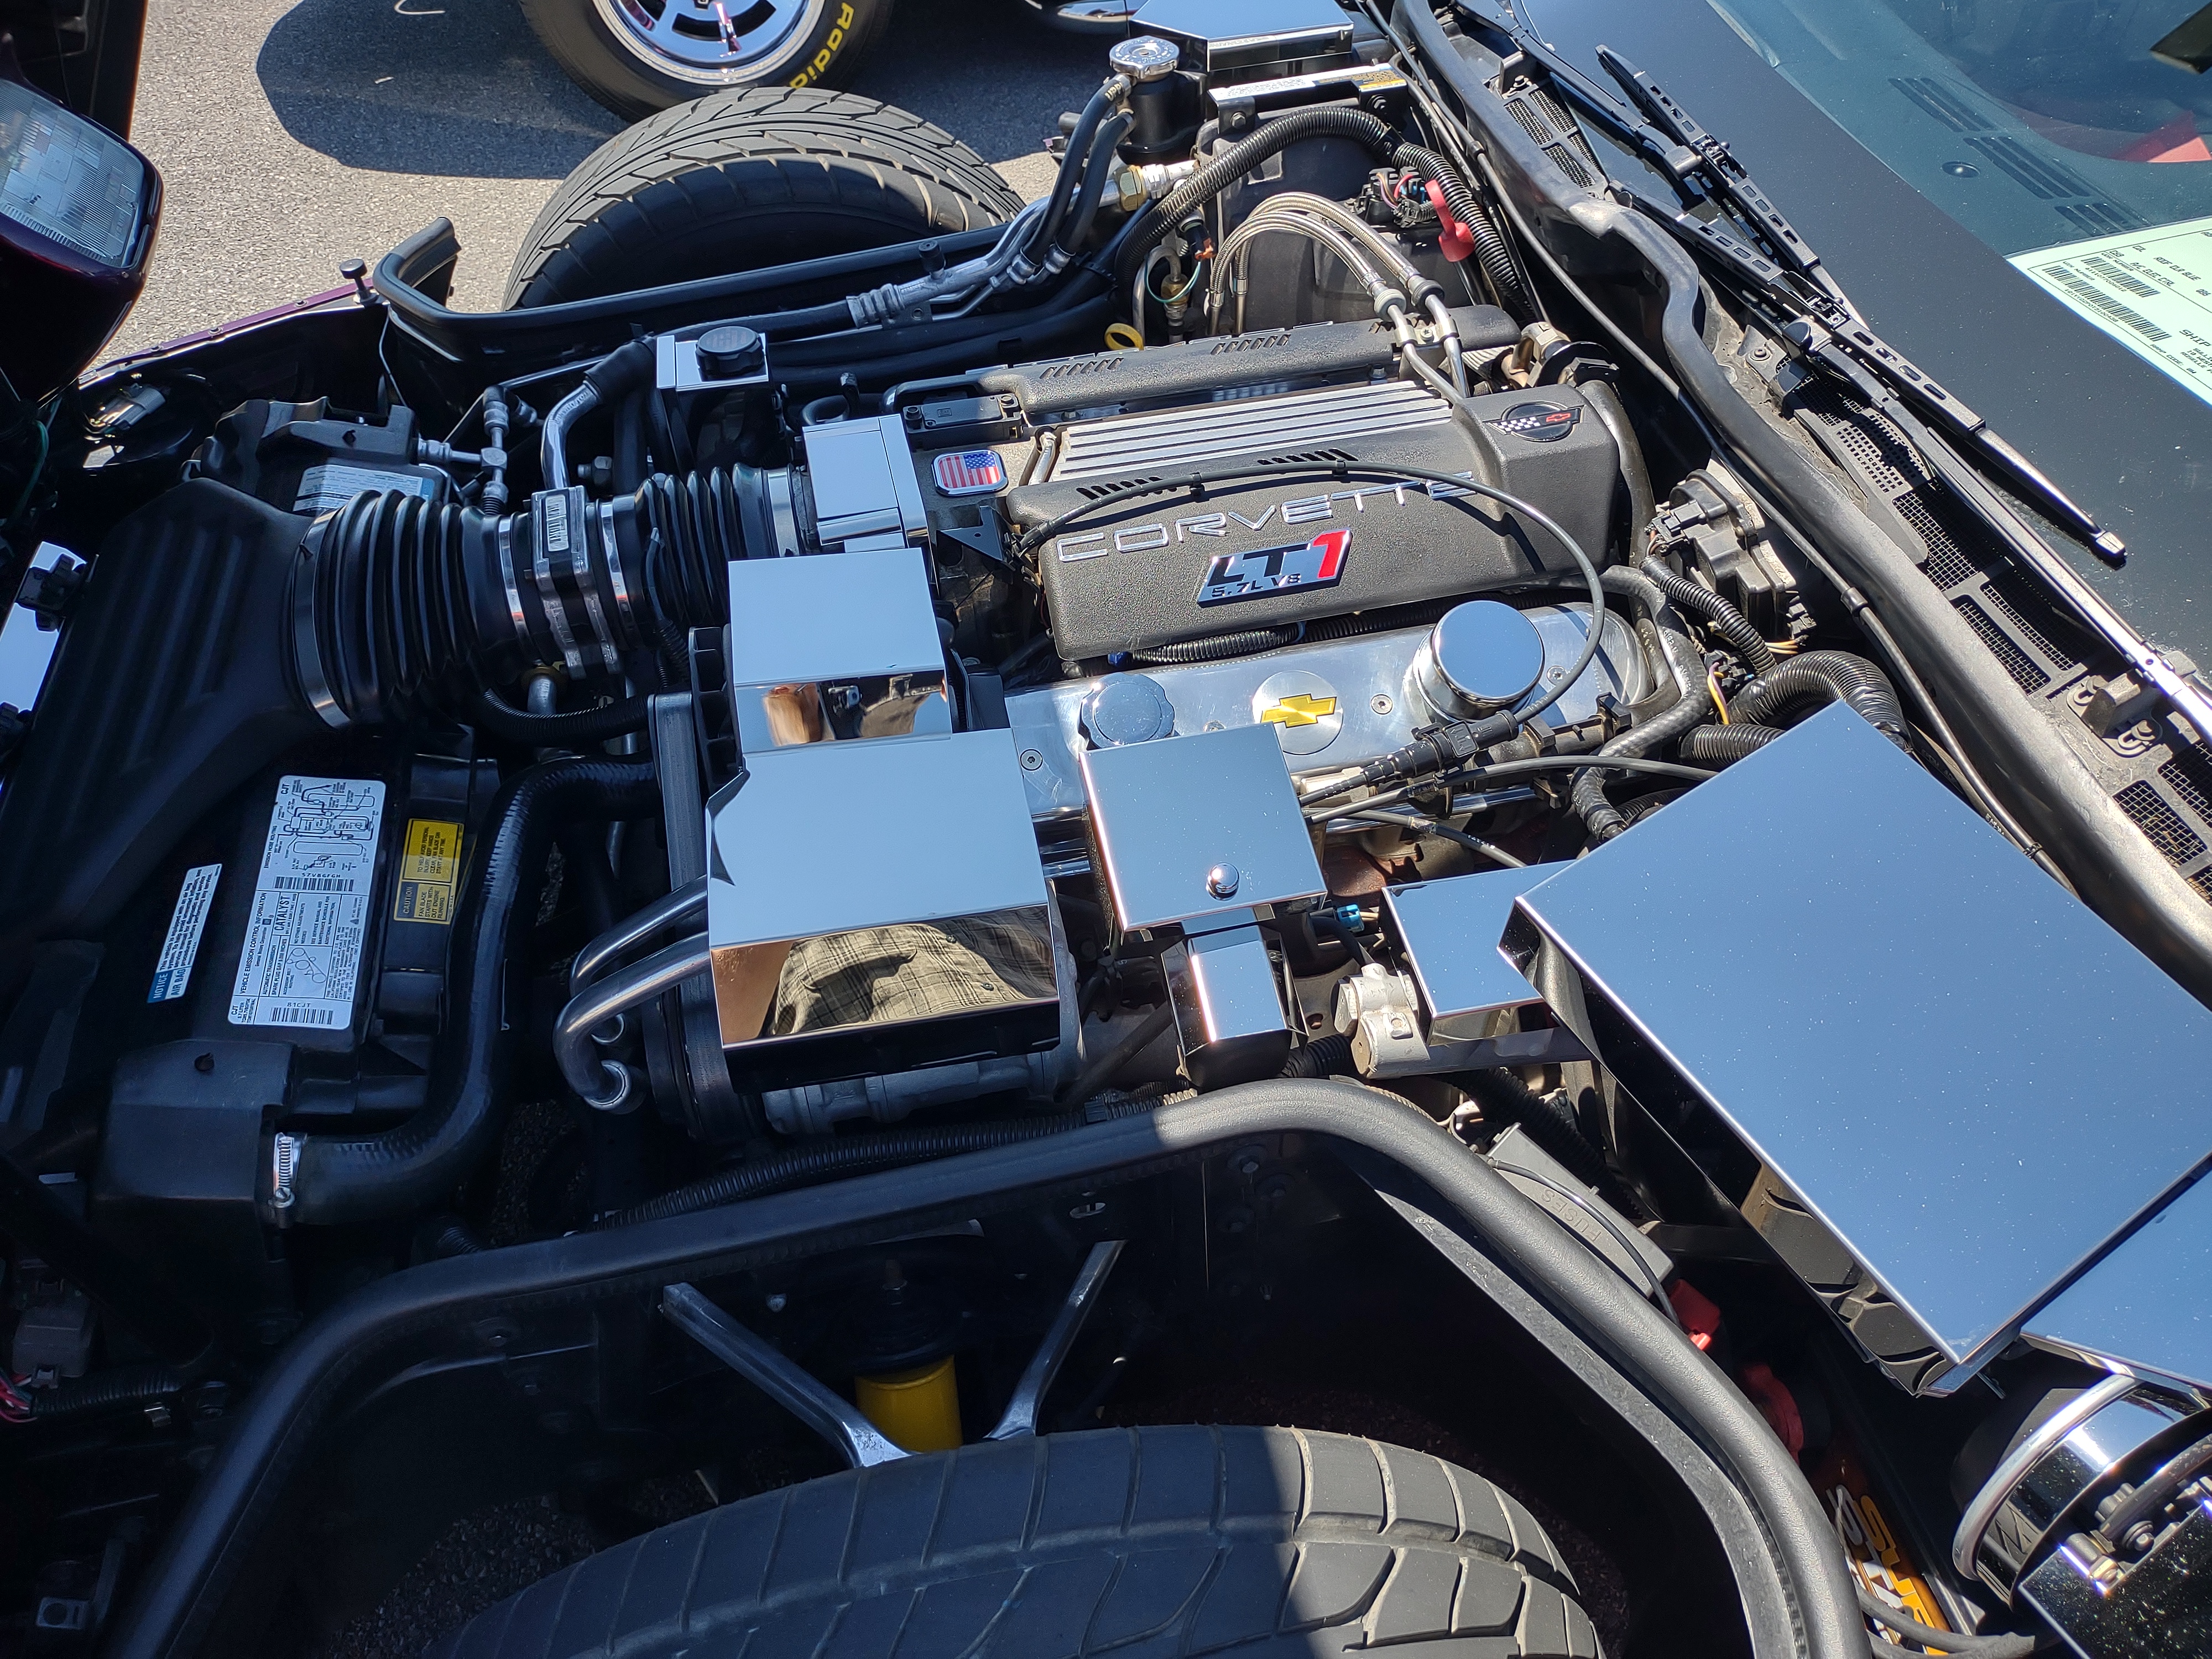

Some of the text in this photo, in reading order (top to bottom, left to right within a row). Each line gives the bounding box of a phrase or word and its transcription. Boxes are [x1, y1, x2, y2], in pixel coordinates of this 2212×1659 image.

[789, 2, 854, 90] Radia
[2179, 330, 2211, 346] SHIP
[1057, 471, 1476, 562] CORVETTE
[1207, 530, 1350, 587] LT1
[1211, 572, 1302, 598] 5.7L V8
[280, 783, 290, 794] CJT
[254, 892, 267, 924] INFORMATION
[402, 886, 413, 914] CAUTION
[424, 899, 432, 917] STARTS
[273, 895, 291, 931] CATALYST
[249, 924, 260, 947] CONTROL
[163, 942, 173, 959] vehicle
[244, 948, 255, 972] EMISSION
[159, 959, 168, 971] This
[262, 944, 277, 994] AUTOMATIC TRANSMISSION
[153, 973, 169, 998] NOTICE
[170, 968, 186, 995] AIR BAG
[239, 972, 250, 994] VEHICLE
[231, 1005, 239, 1015] CJT
[1541, 1189, 1602, 1243] FUSES
